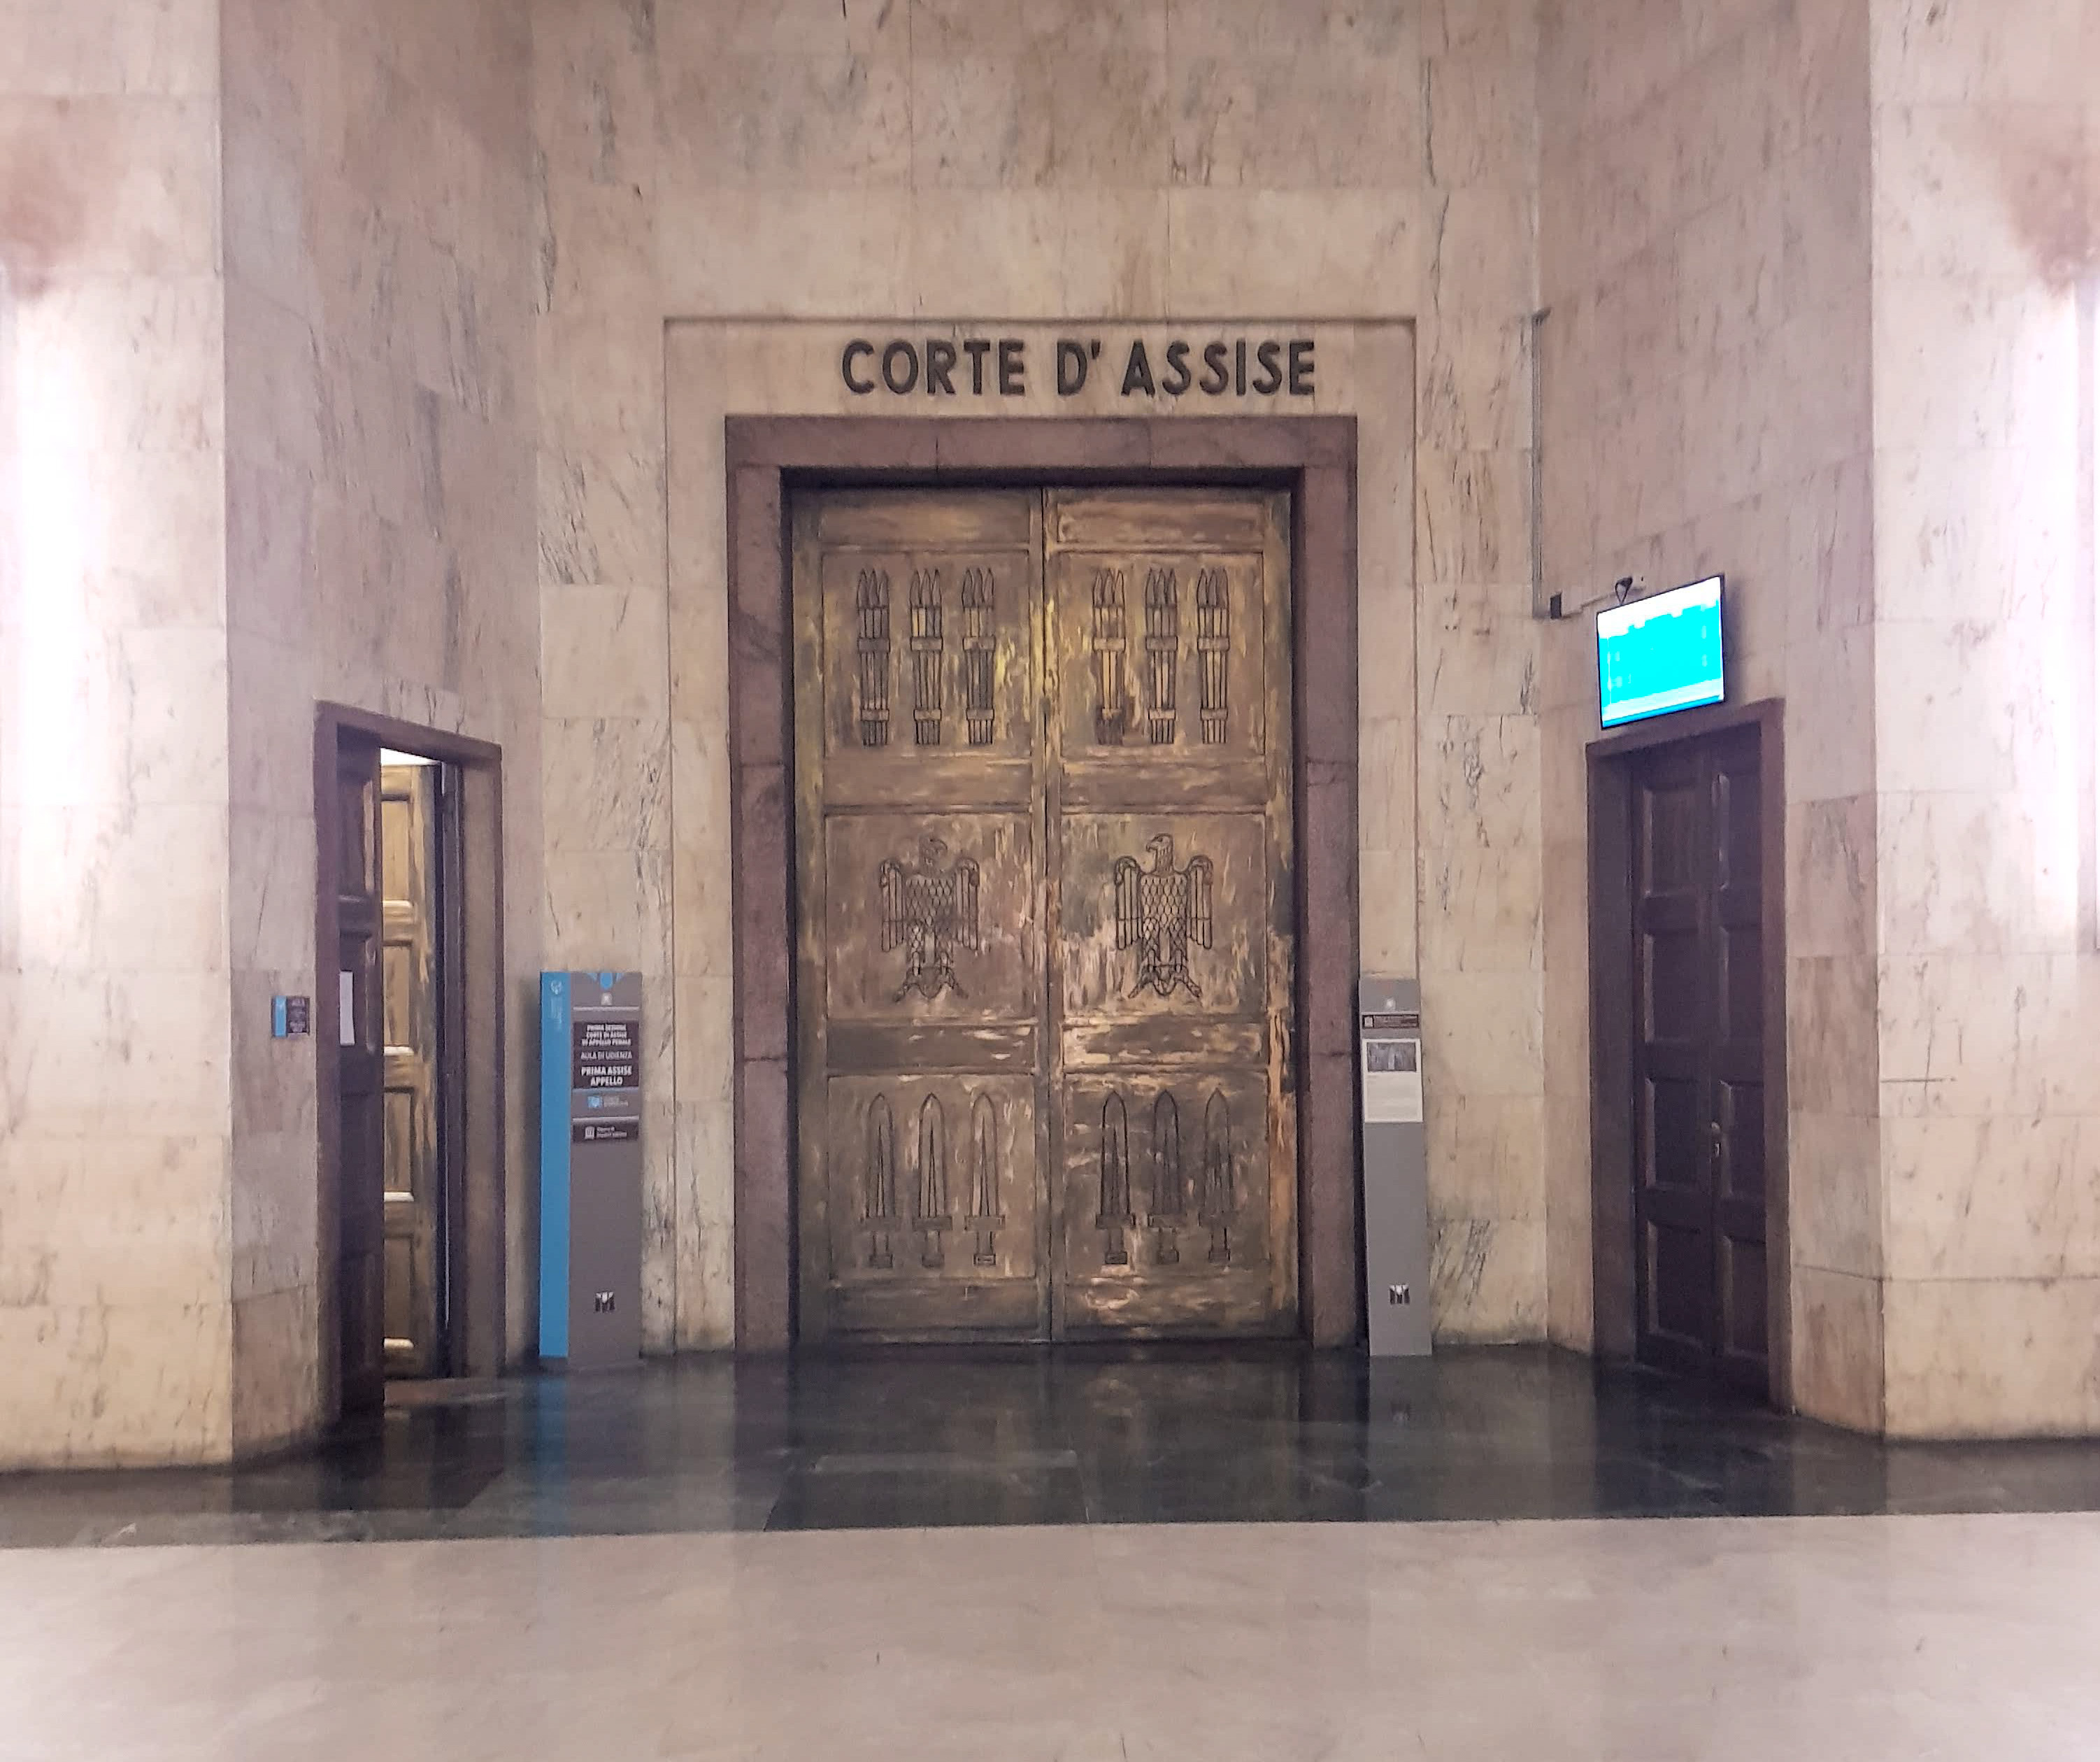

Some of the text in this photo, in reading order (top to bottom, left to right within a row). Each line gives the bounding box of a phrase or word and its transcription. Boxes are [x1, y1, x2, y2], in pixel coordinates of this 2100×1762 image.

[842, 338, 1315, 397] CORTE D' ASSISE
[580, 1051, 632, 1060] AULA DI UDIENZA
[581, 1065, 632, 1076] PRIMA ASSISE
[590, 1077, 623, 1086] APPELLO
